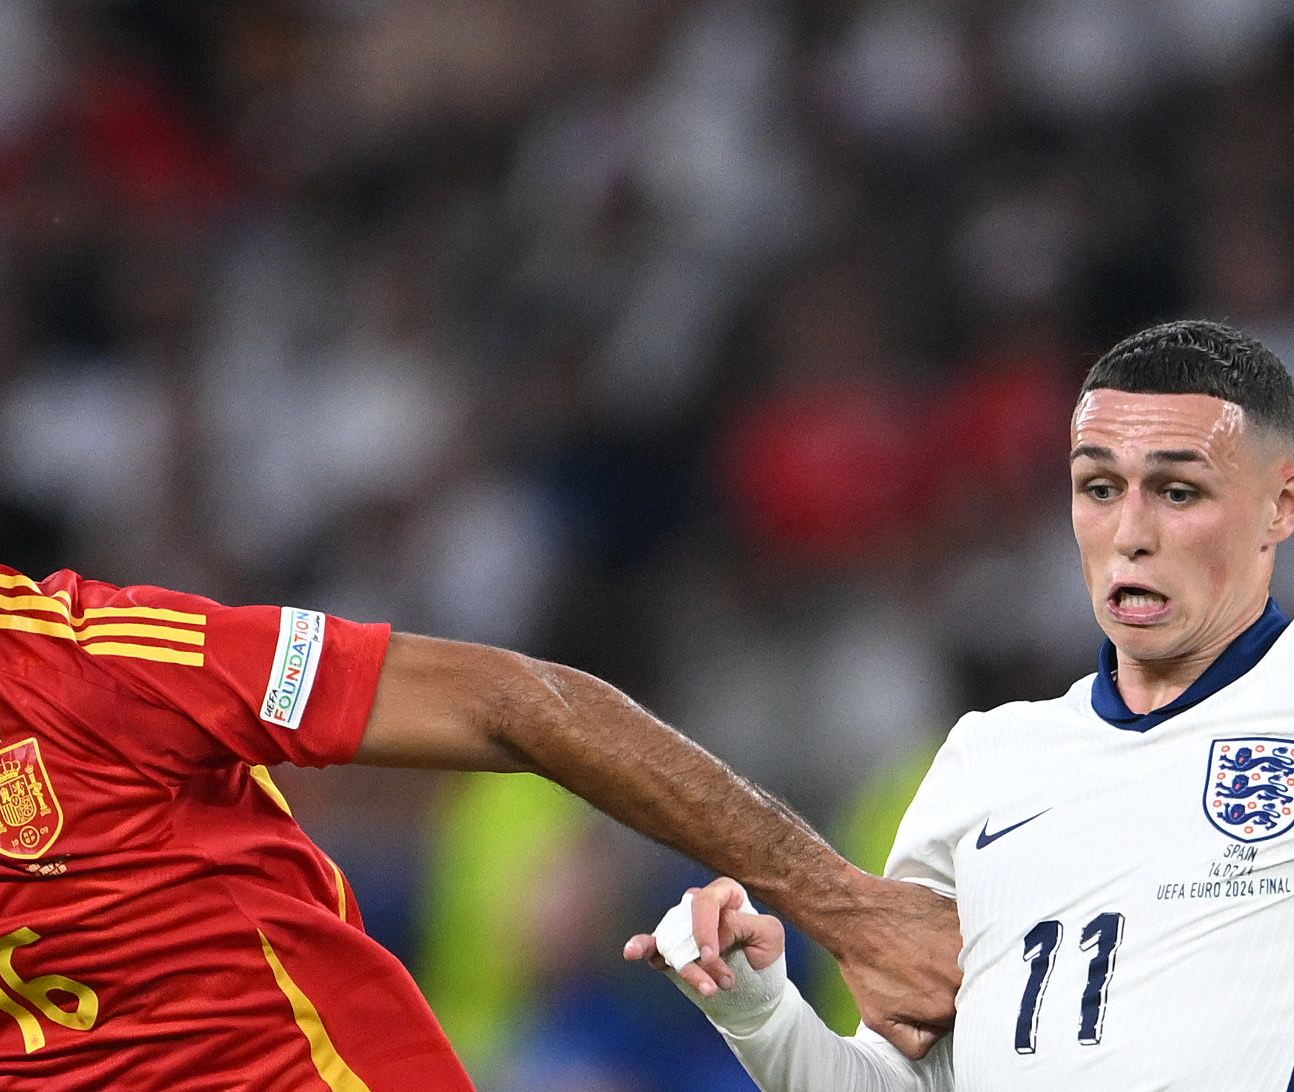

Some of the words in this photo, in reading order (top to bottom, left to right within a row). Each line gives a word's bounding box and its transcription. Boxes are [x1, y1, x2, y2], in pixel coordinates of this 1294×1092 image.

[274, 611, 310, 722] FOUNDATION
[264, 689, 278, 717] UEFA
[1223, 844, 1259, 862] SPAIN
[1156, 883, 1186, 900] UEFA
[1190, 882, 1221, 898] EURO
[1225, 880, 1254, 897] 2024
[1259, 877, 1291, 895] FINAL
[1015, 912, 1126, 1056] 11
